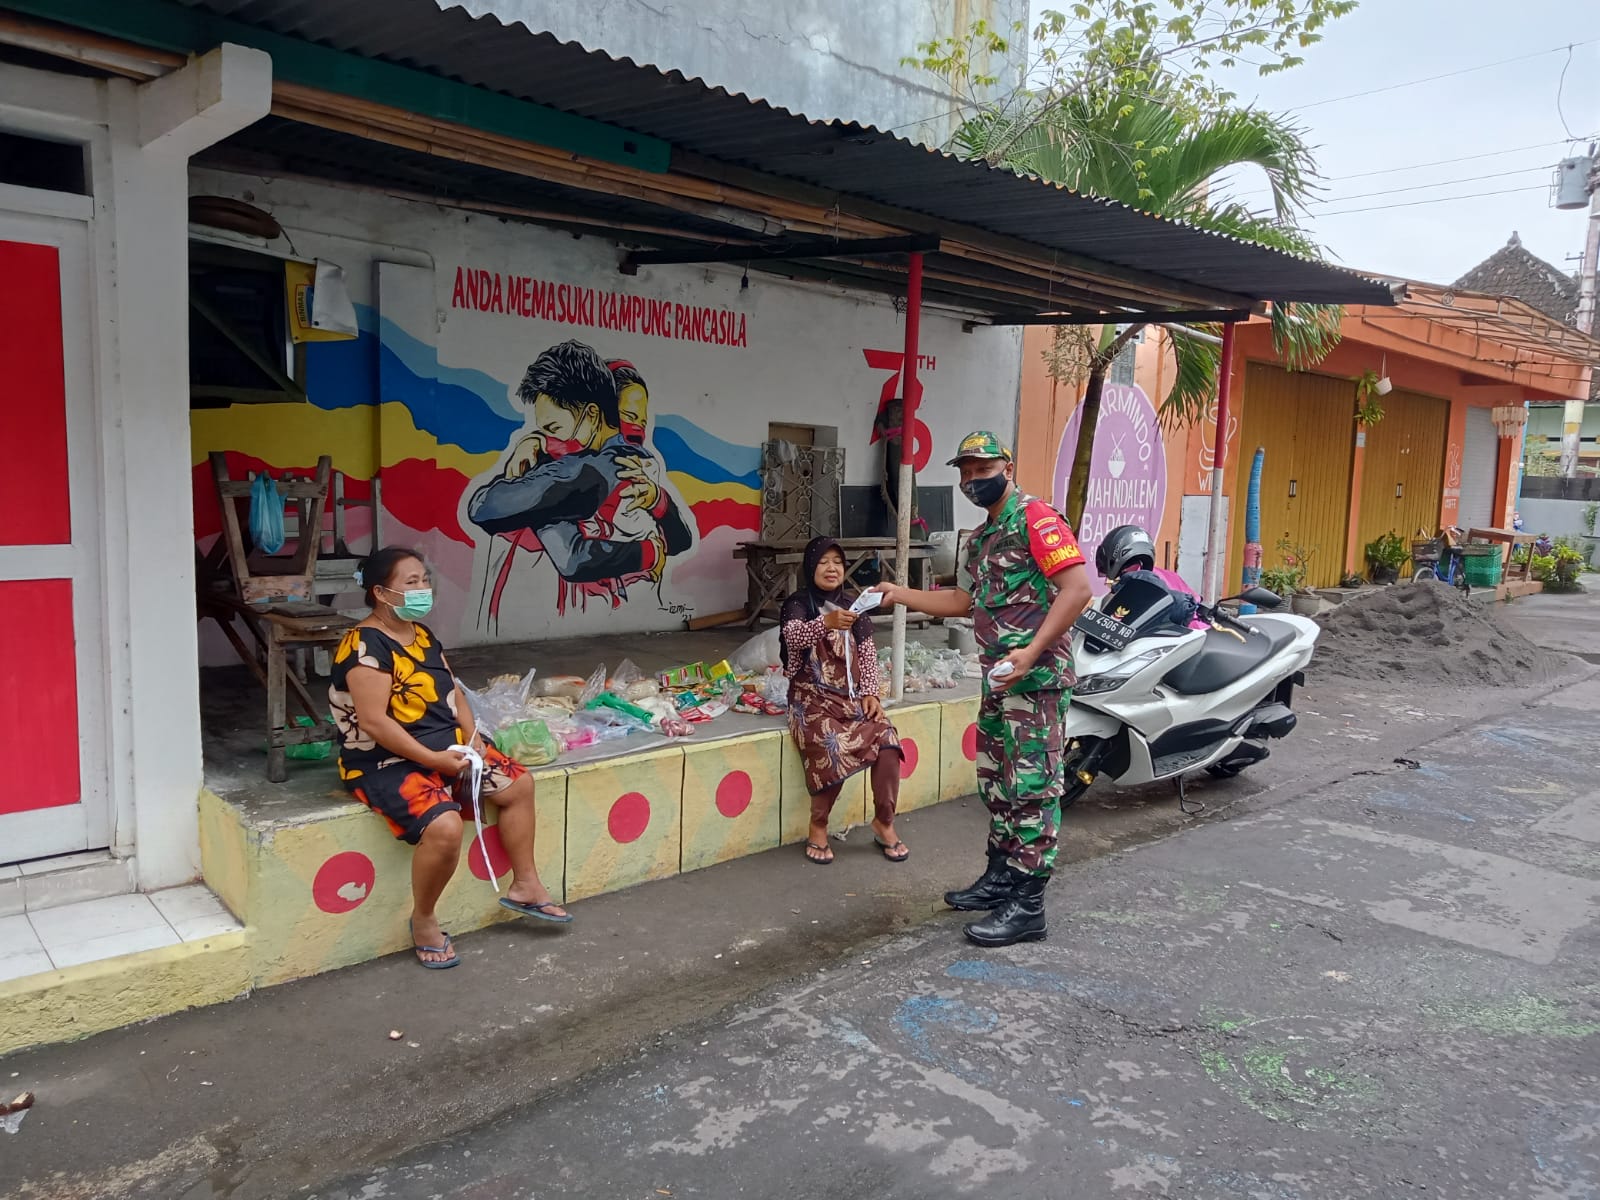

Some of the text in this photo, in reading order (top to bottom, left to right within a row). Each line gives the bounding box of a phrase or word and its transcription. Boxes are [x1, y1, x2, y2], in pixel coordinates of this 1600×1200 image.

[452, 266, 747, 348] ANDA MEMASUKI KAMPUNG PANCASILA
[1097, 387, 1151, 462] ARMINDO
[1041, 544, 1081, 571] BABINSA
[1084, 610, 1132, 638] AD 4506 NB
